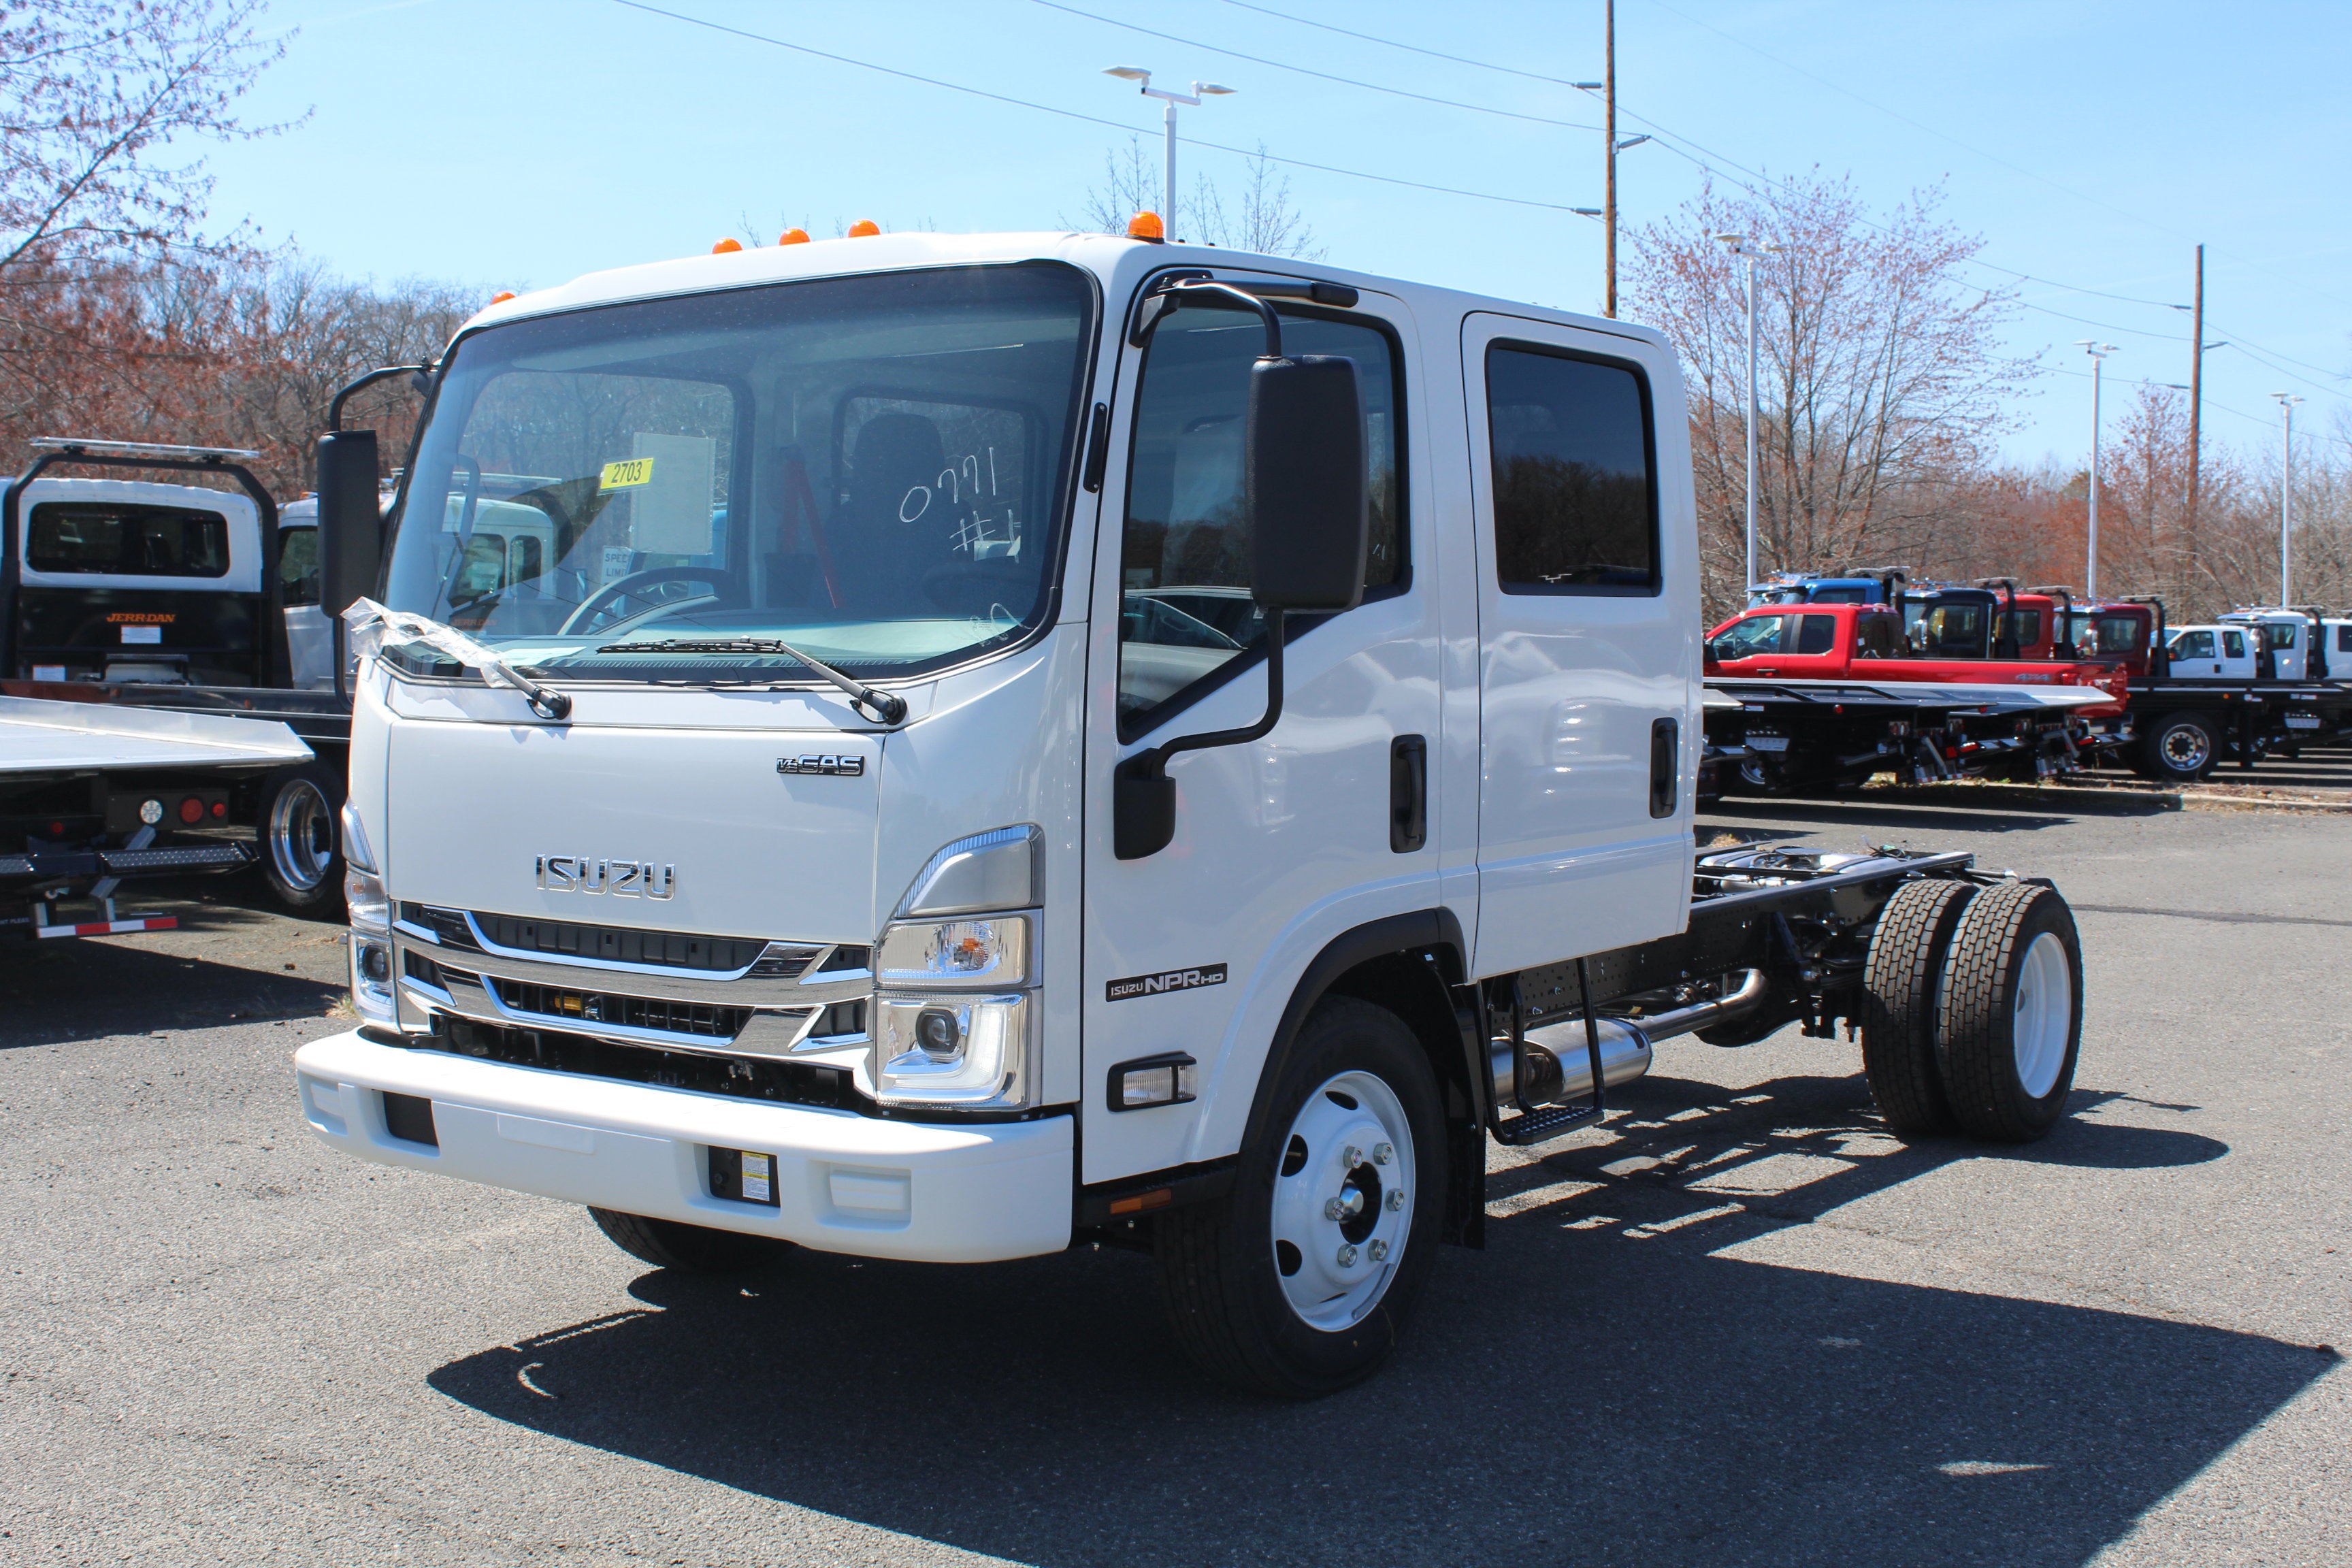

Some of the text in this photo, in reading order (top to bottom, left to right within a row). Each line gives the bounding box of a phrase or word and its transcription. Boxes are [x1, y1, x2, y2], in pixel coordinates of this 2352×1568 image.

[610, 461, 642, 484] 2703
[899, 446, 996, 523] 0771
[604, 553, 630, 564] SPEE
[798, 754, 862, 775] GAS
[536, 854, 675, 901] ISUZU
[1111, 970, 1224, 996] ISUZU NPR HD
